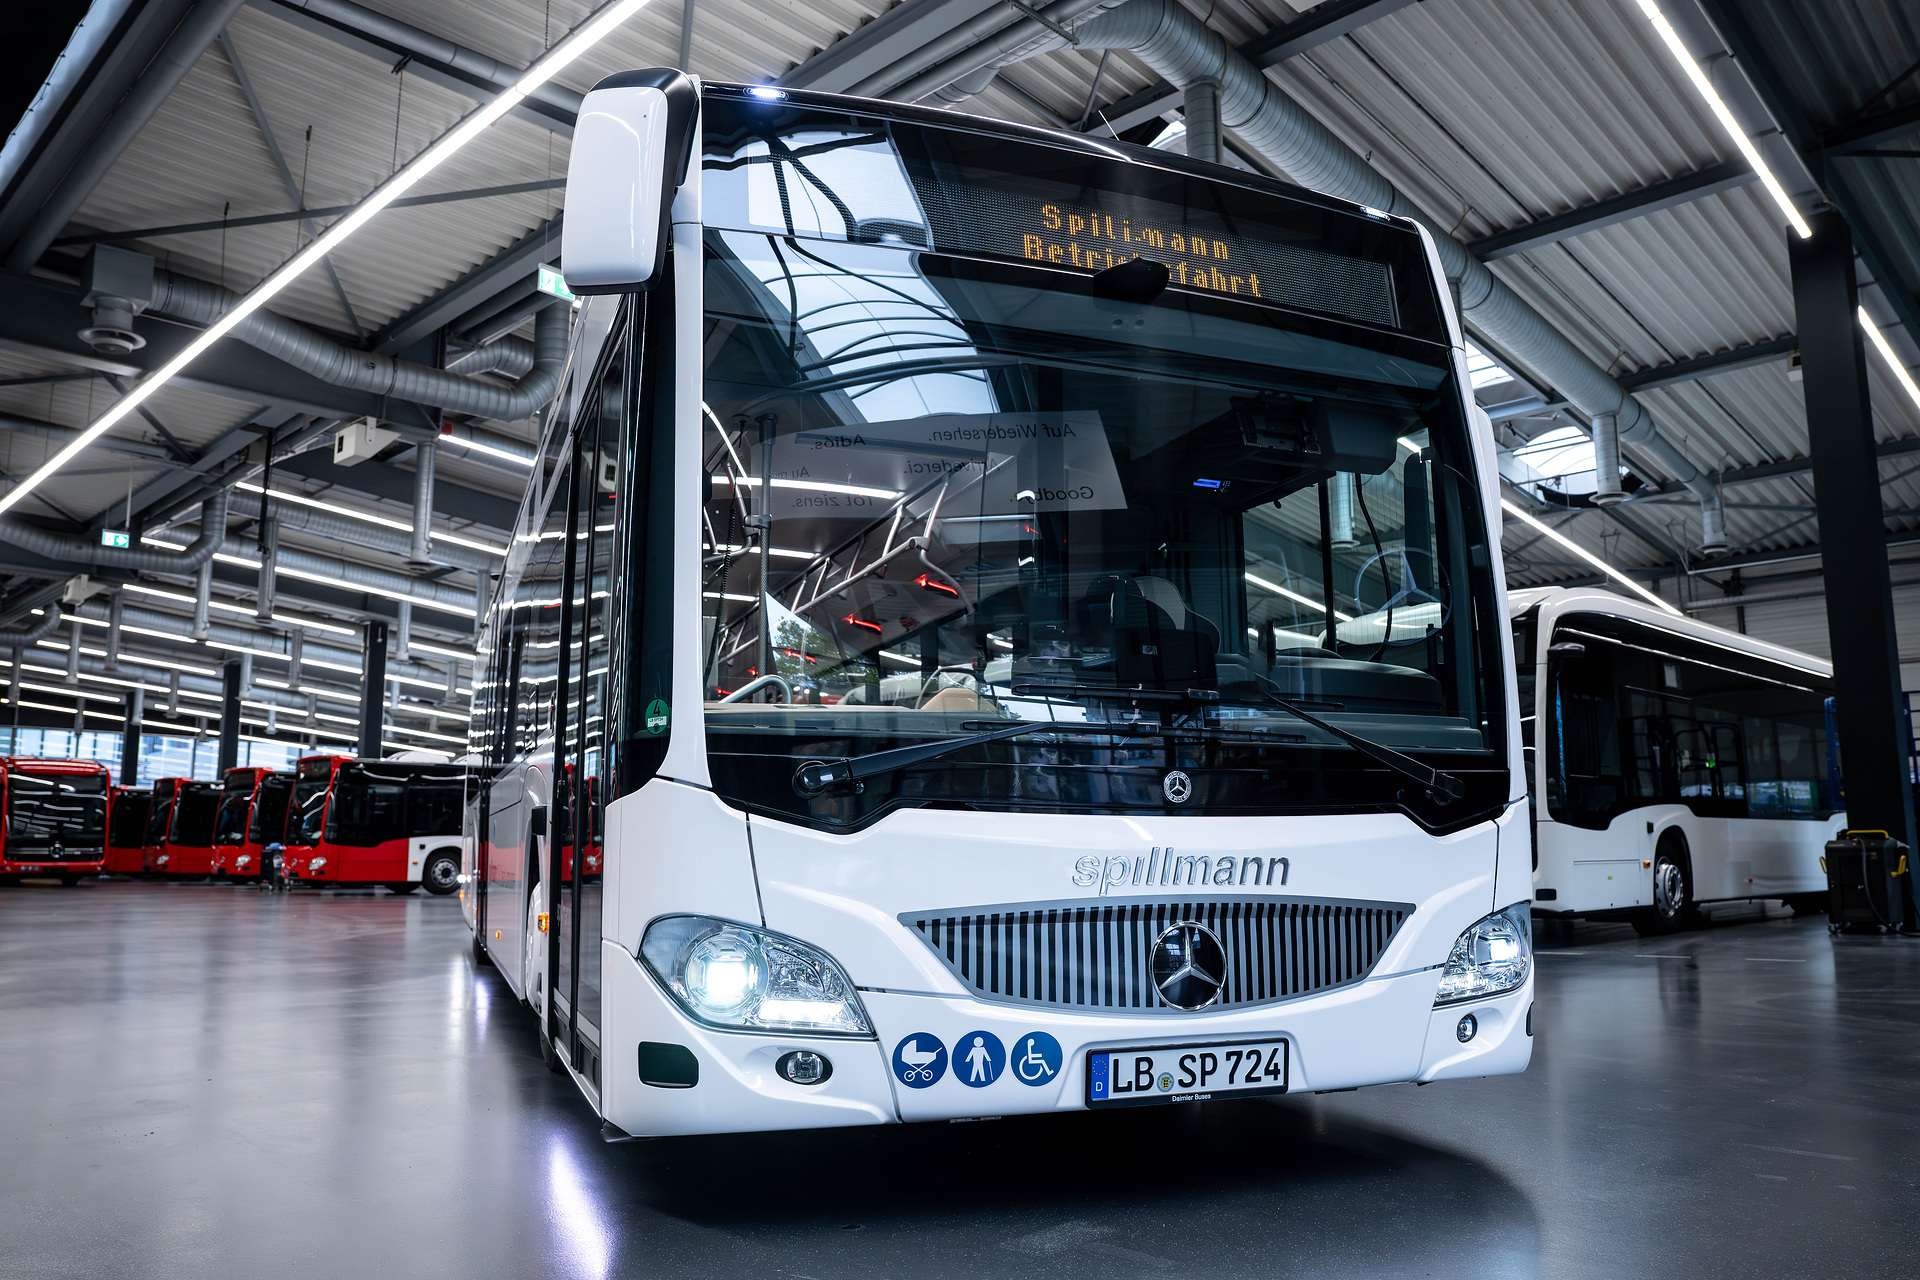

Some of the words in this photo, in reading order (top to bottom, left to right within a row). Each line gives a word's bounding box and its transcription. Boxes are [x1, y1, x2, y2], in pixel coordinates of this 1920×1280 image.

[1023, 234, 1262, 298] Betrifahrt
[653, 700, 661, 716] 4
[1072, 847, 1290, 897] spillmann
[1112, 1056, 1155, 1093] LB
[1177, 1052, 1218, 1088] SP
[1225, 1047, 1281, 1085] 724
[1095, 1081, 1103, 1092] D
[1171, 1094, 1194, 1102] Daimler
